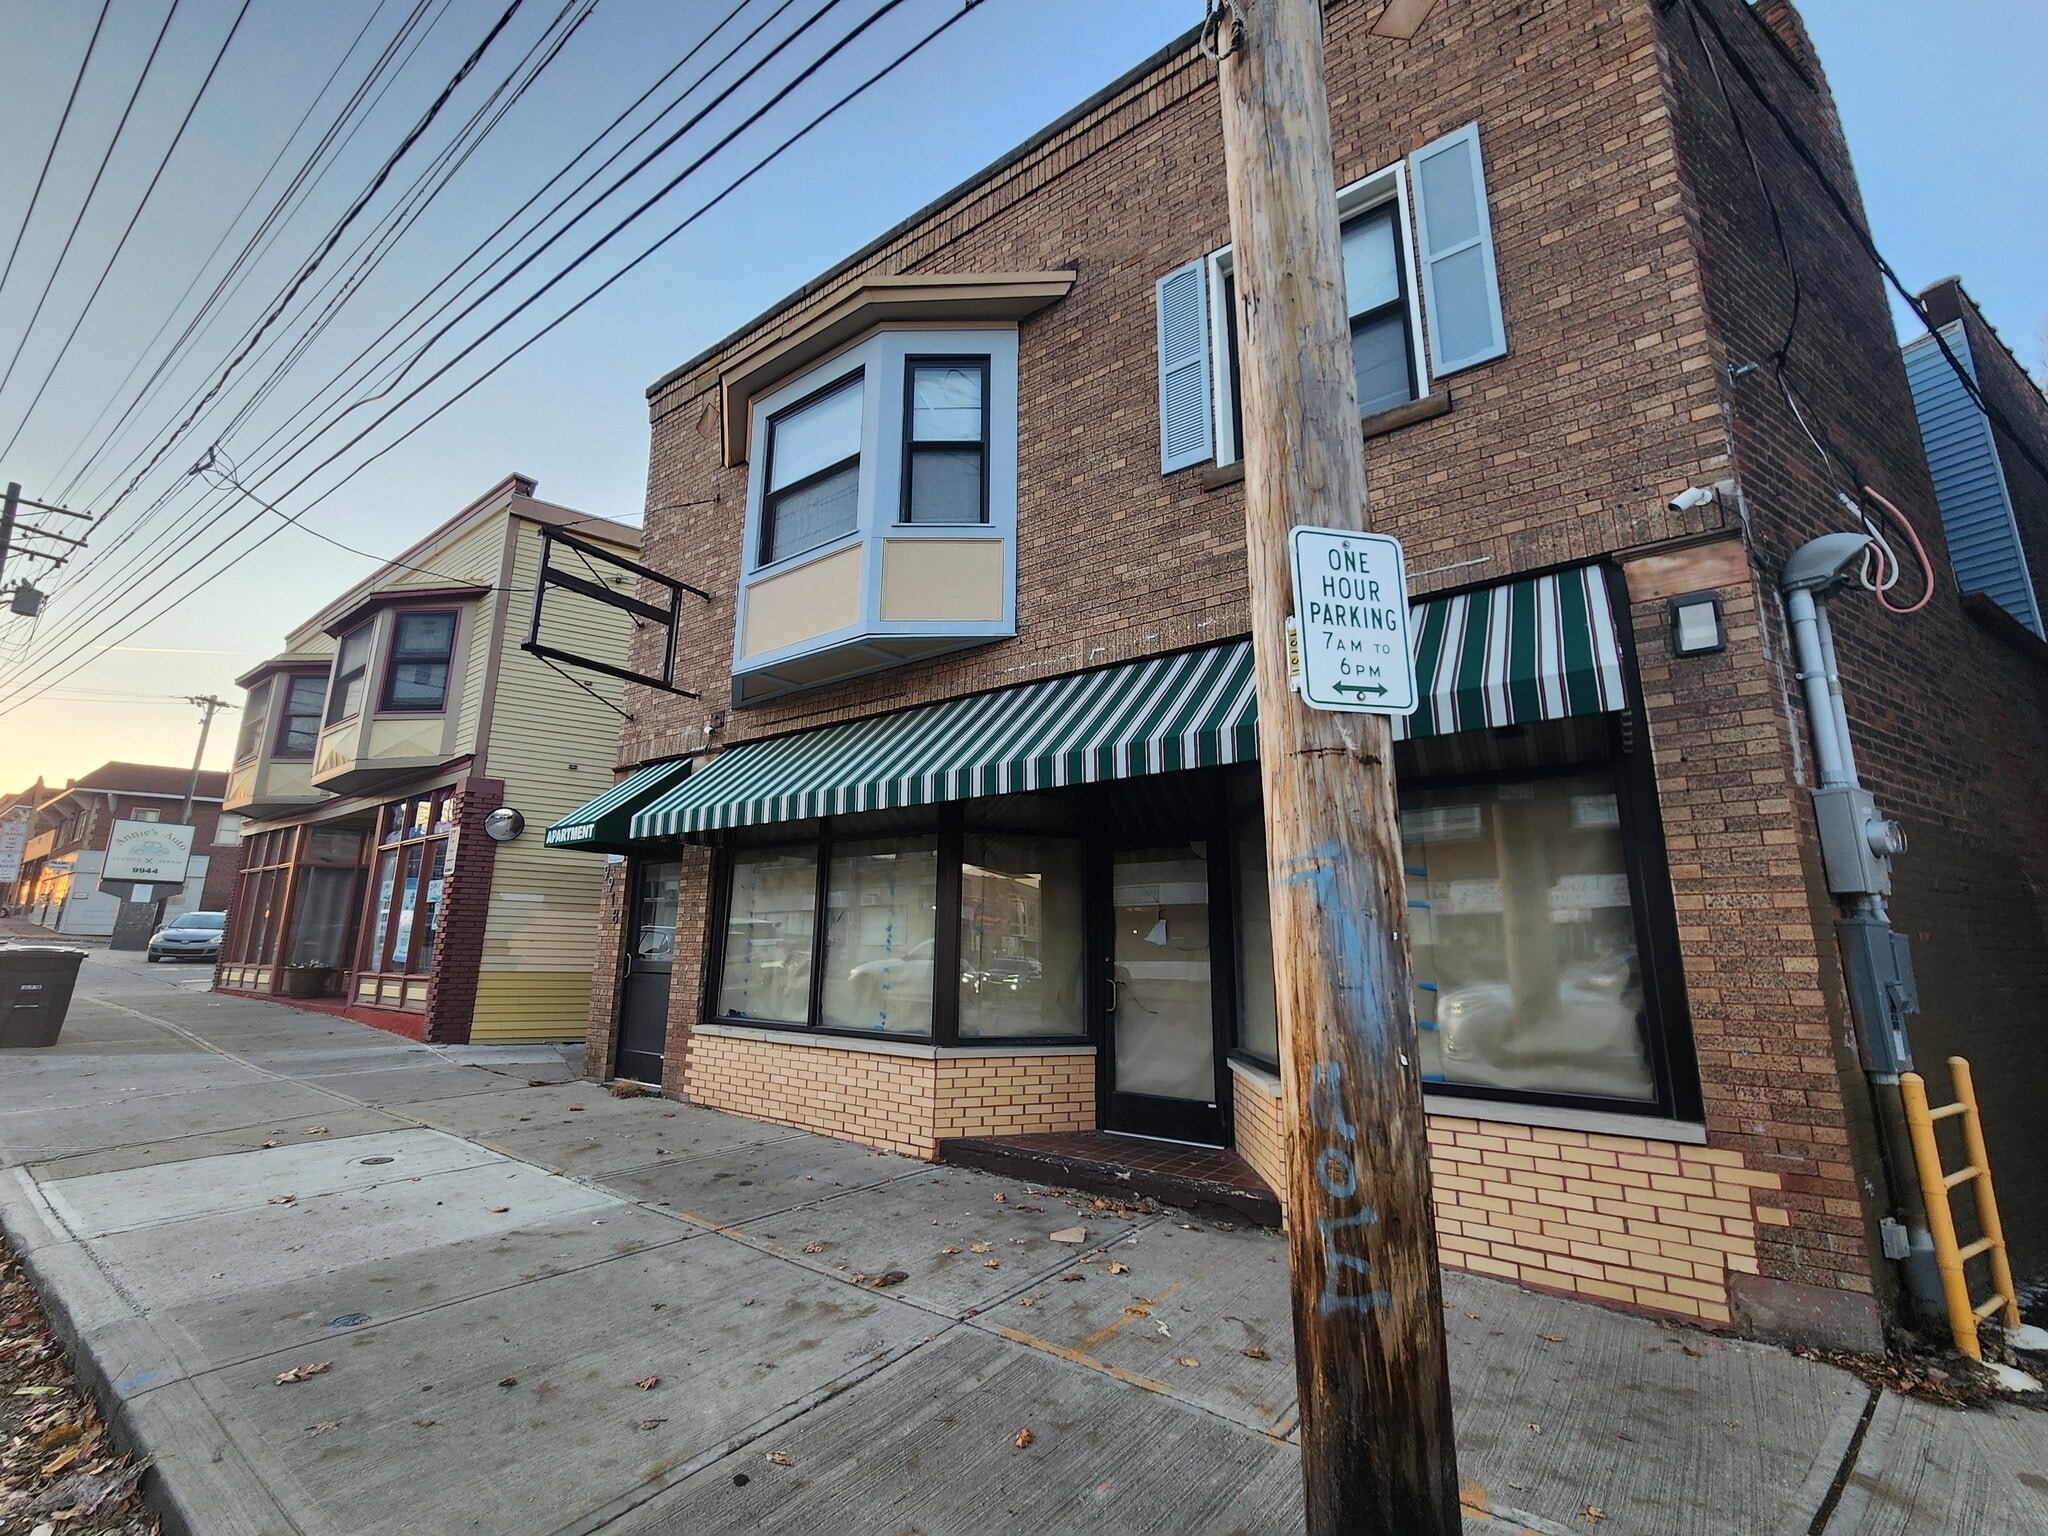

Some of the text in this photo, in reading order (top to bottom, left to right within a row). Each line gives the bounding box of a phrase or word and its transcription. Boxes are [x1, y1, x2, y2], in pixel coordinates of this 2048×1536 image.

[1328, 549, 1370, 574] ONE
[1322, 575, 1380, 602] HOUR
[1310, 601, 1397, 631] PARKING
[1374, 643, 1391, 655] TO
[115, 828, 187, 851] Annie's Auto
[545, 823, 595, 845] APARTMENT
[132, 866, 159, 874] 9944
[603, 864, 619, 924] 9918
